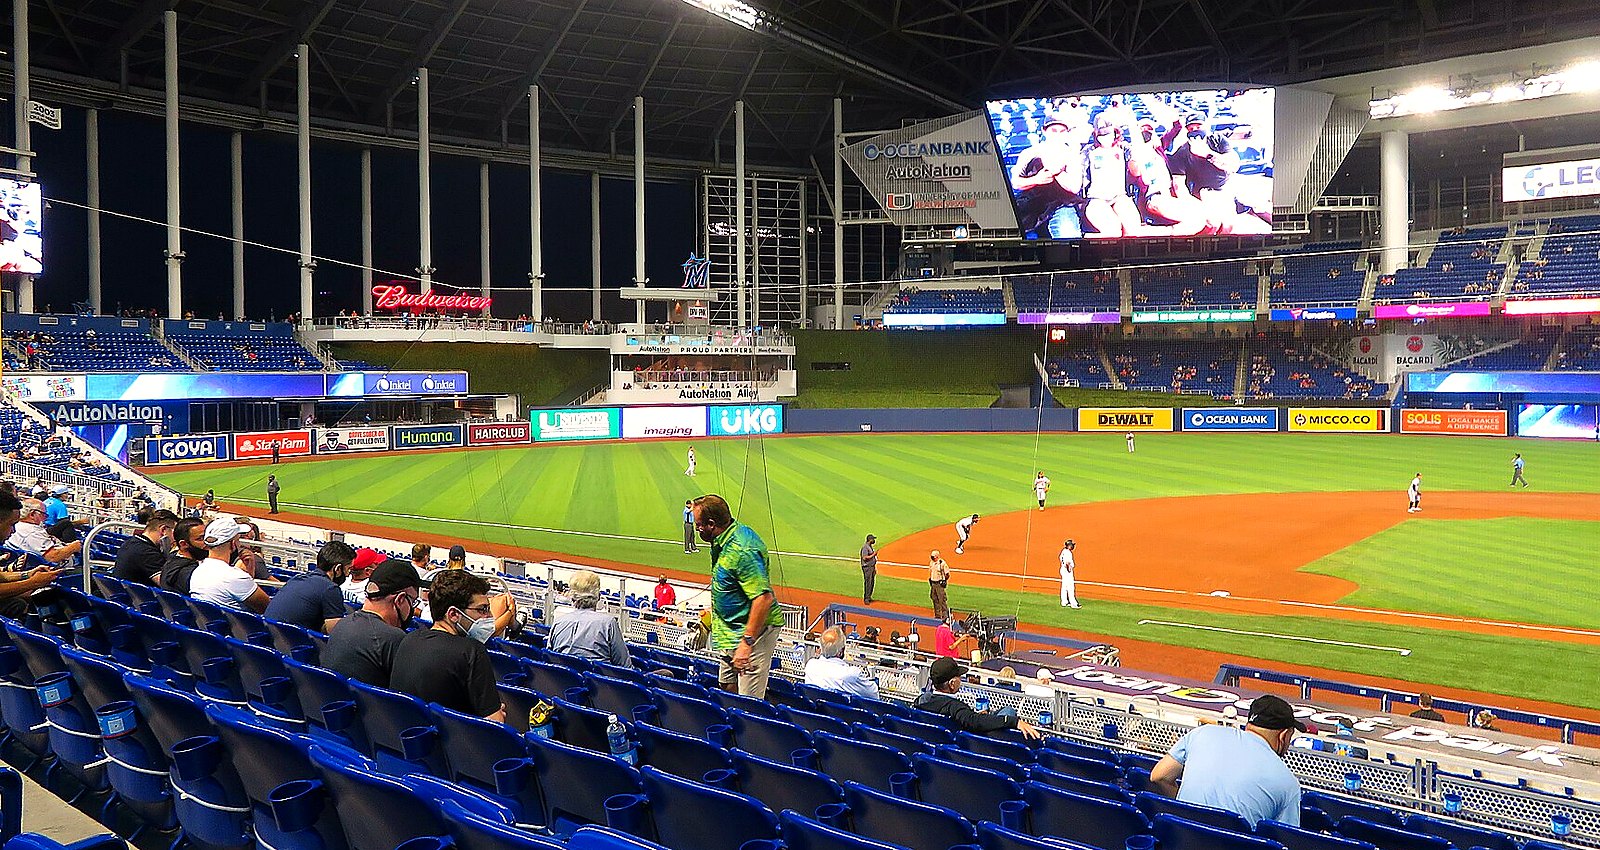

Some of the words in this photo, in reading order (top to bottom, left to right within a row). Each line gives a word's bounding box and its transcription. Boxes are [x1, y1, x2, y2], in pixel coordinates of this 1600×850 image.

[34, 104, 55, 118] 2003
[886, 164, 971, 179] AutoNation
[914, 192, 961, 200] UNIVERSITY
[974, 191, 1000, 200] MIAMI
[372, 285, 493, 309] Budweiser
[639, 345, 671, 354] AutoNation
[714, 346, 752, 354] PARTNERS
[679, 389, 731, 399] AutoNation
[56, 403, 163, 422] AutoNation
[1206, 415, 1239, 424] OCEAN
[1241, 415, 1268, 424] BANK
[1309, 415, 1371, 425] MICCO.CO
[1407, 413, 1442, 424] SOLIS
[644, 426, 693, 436] imaging
[162, 439, 213, 459] GOYA
[1382, 725, 1564, 767] park
